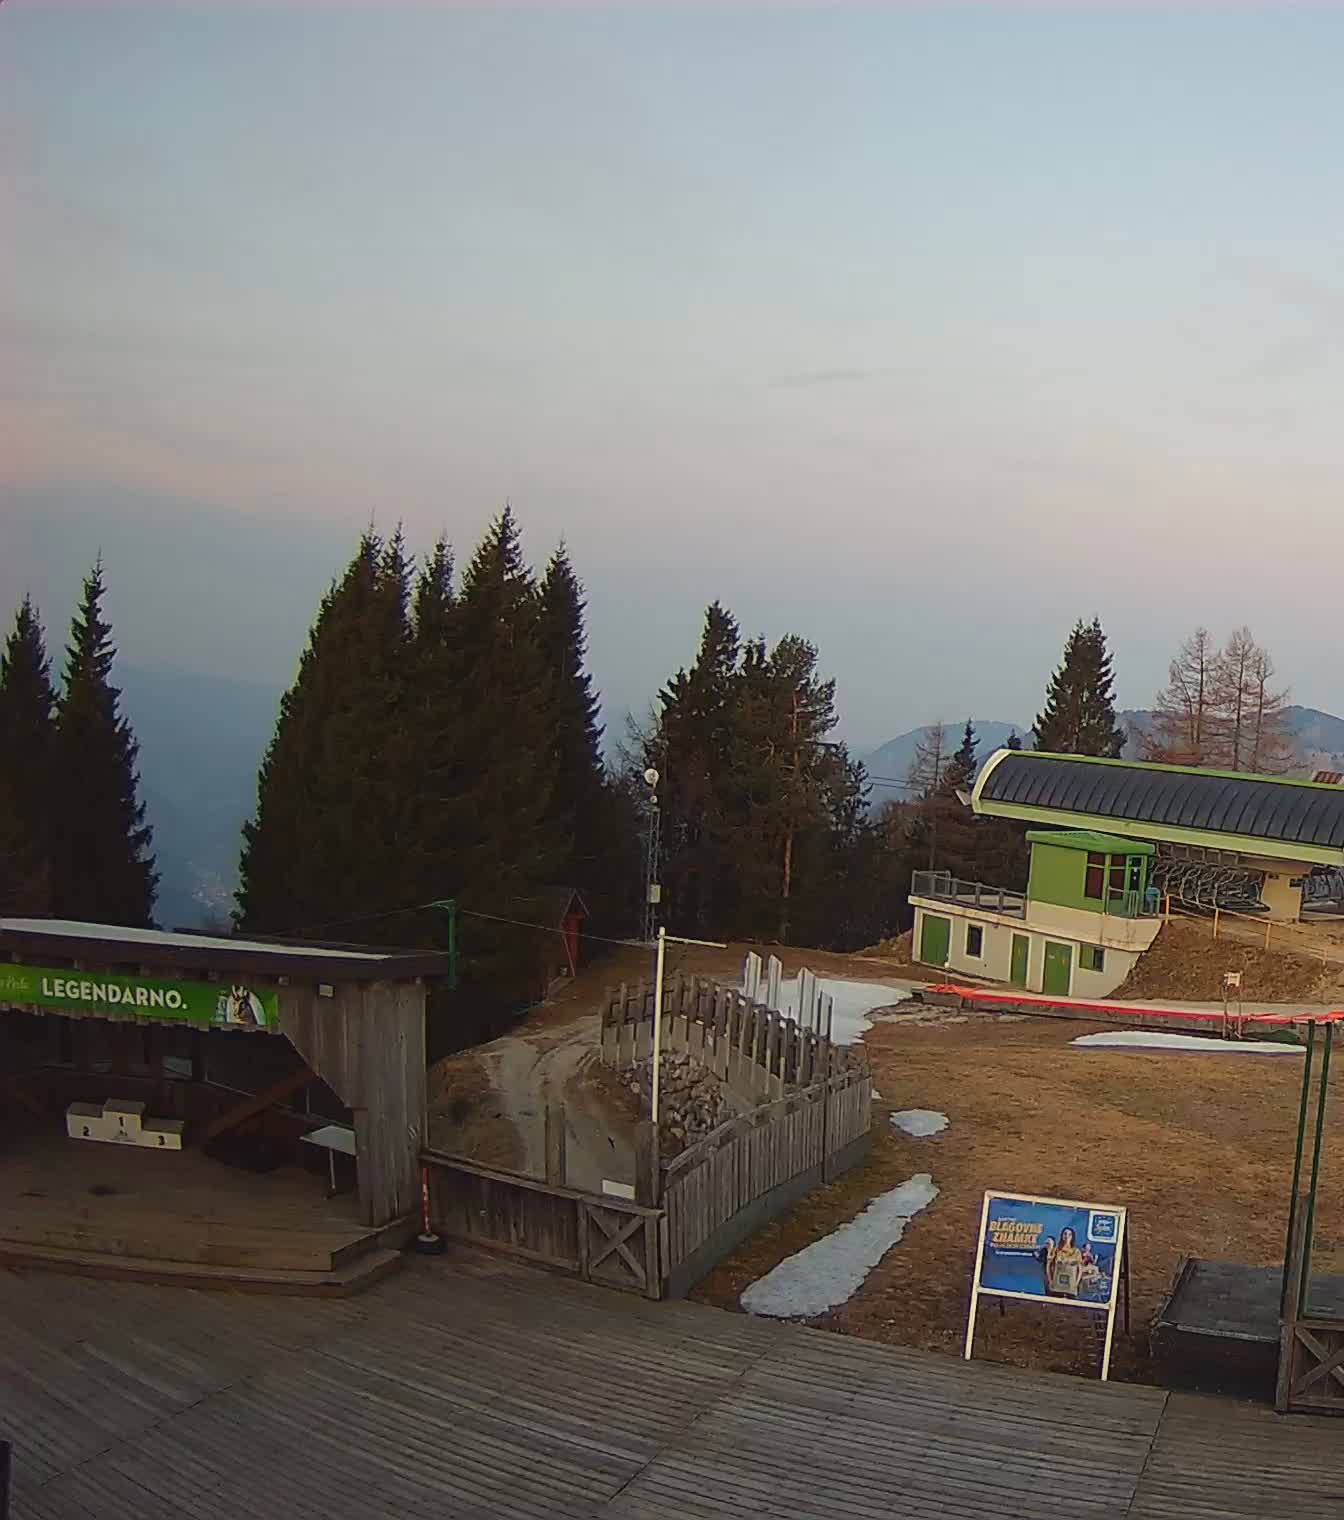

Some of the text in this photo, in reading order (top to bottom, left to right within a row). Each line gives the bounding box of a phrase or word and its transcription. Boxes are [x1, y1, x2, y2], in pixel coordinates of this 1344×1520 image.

[42, 977, 188, 1009] LEGENDARNO.
[83, 1126, 90, 1136] 2
[158, 1135, 165, 1145] 3
